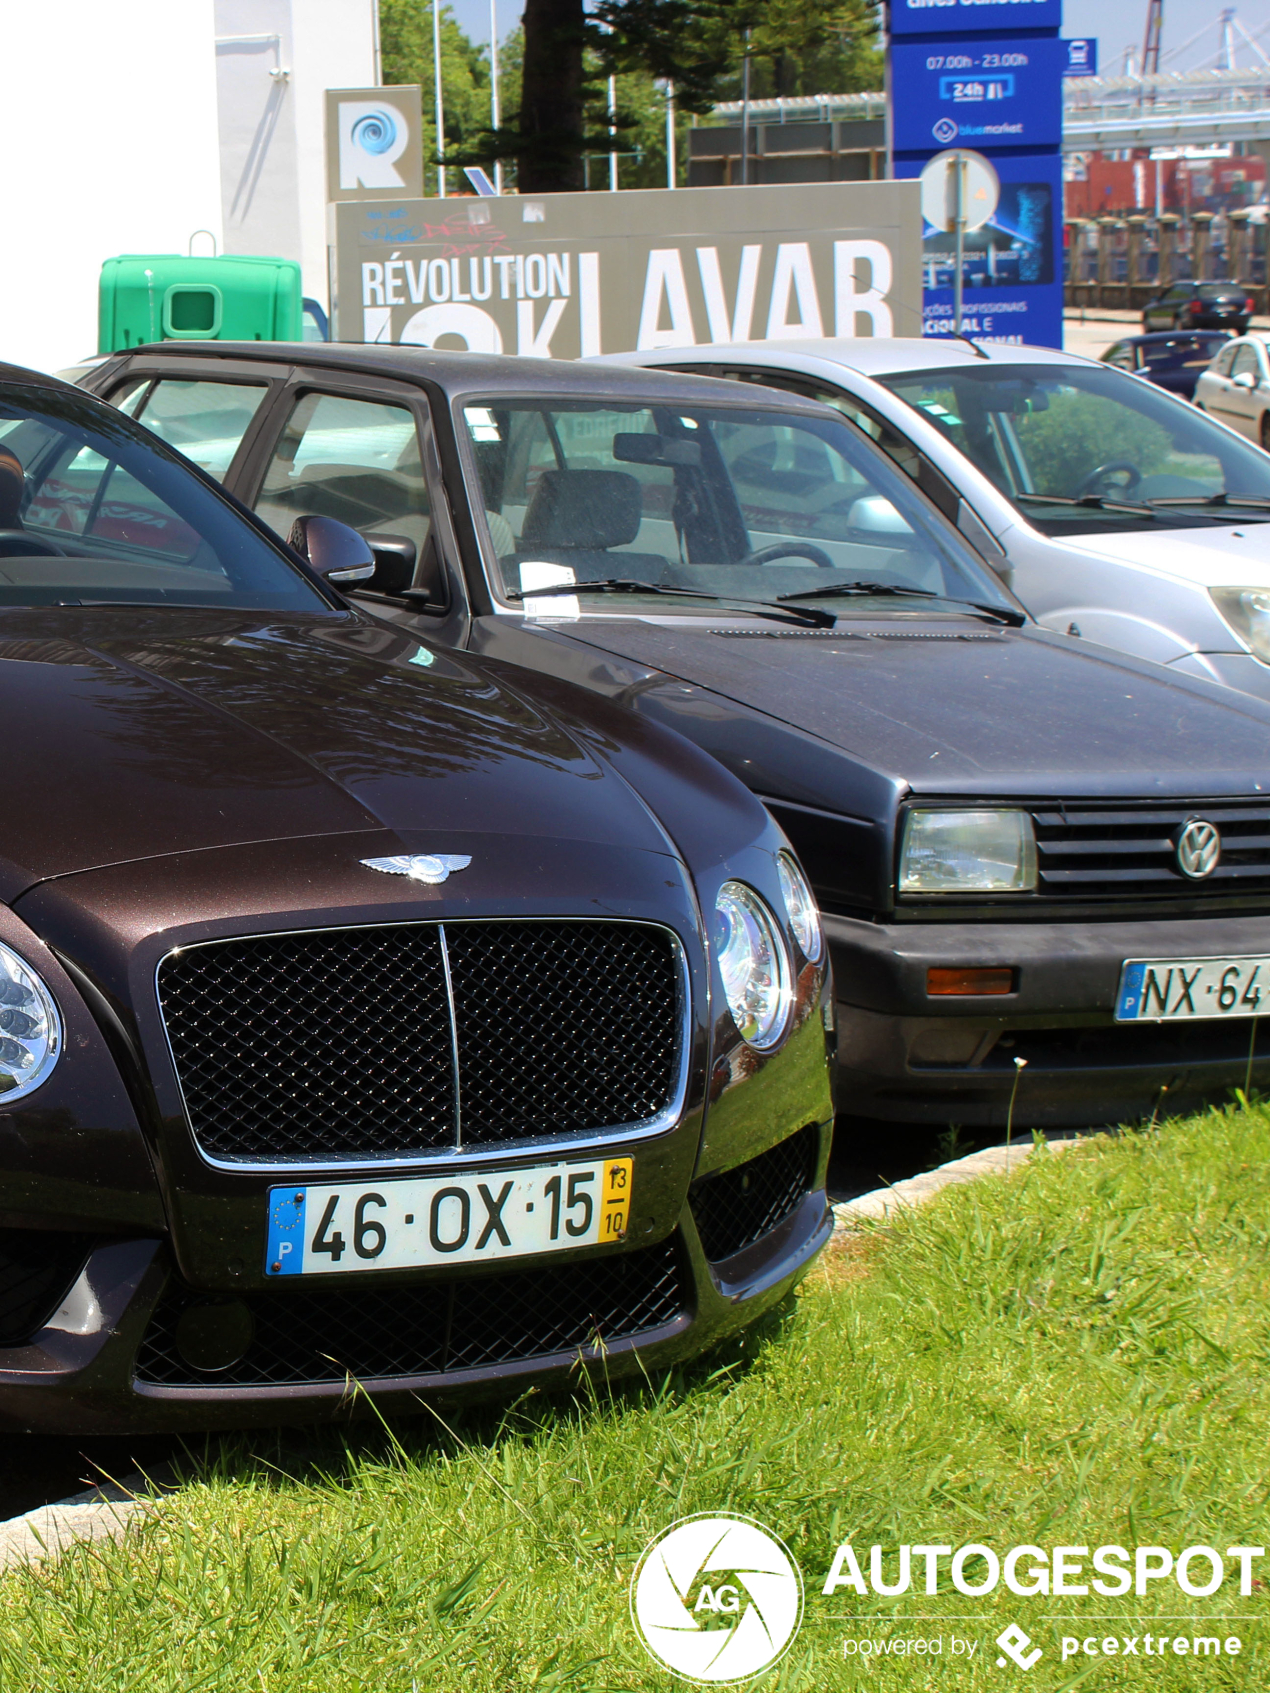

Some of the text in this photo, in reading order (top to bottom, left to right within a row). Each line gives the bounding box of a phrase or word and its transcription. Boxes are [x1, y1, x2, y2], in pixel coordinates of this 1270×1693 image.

[926, 56, 972, 70] 07.00h
[982, 53, 1028, 68] 23.00h
[953, 83, 984, 97] 24h
[959, 122, 1023, 135] bluemarket
[362, 251, 571, 306] RÉVOLUTION
[958, 301, 1029, 314] ROFISSIONAIS
[983, 317, 994, 331] E
[1125, 997, 1135, 1009] P
[278, 1242, 292, 1260] P
[609, 1167, 627, 1189] 13
[606, 1212, 623, 1233] 10
